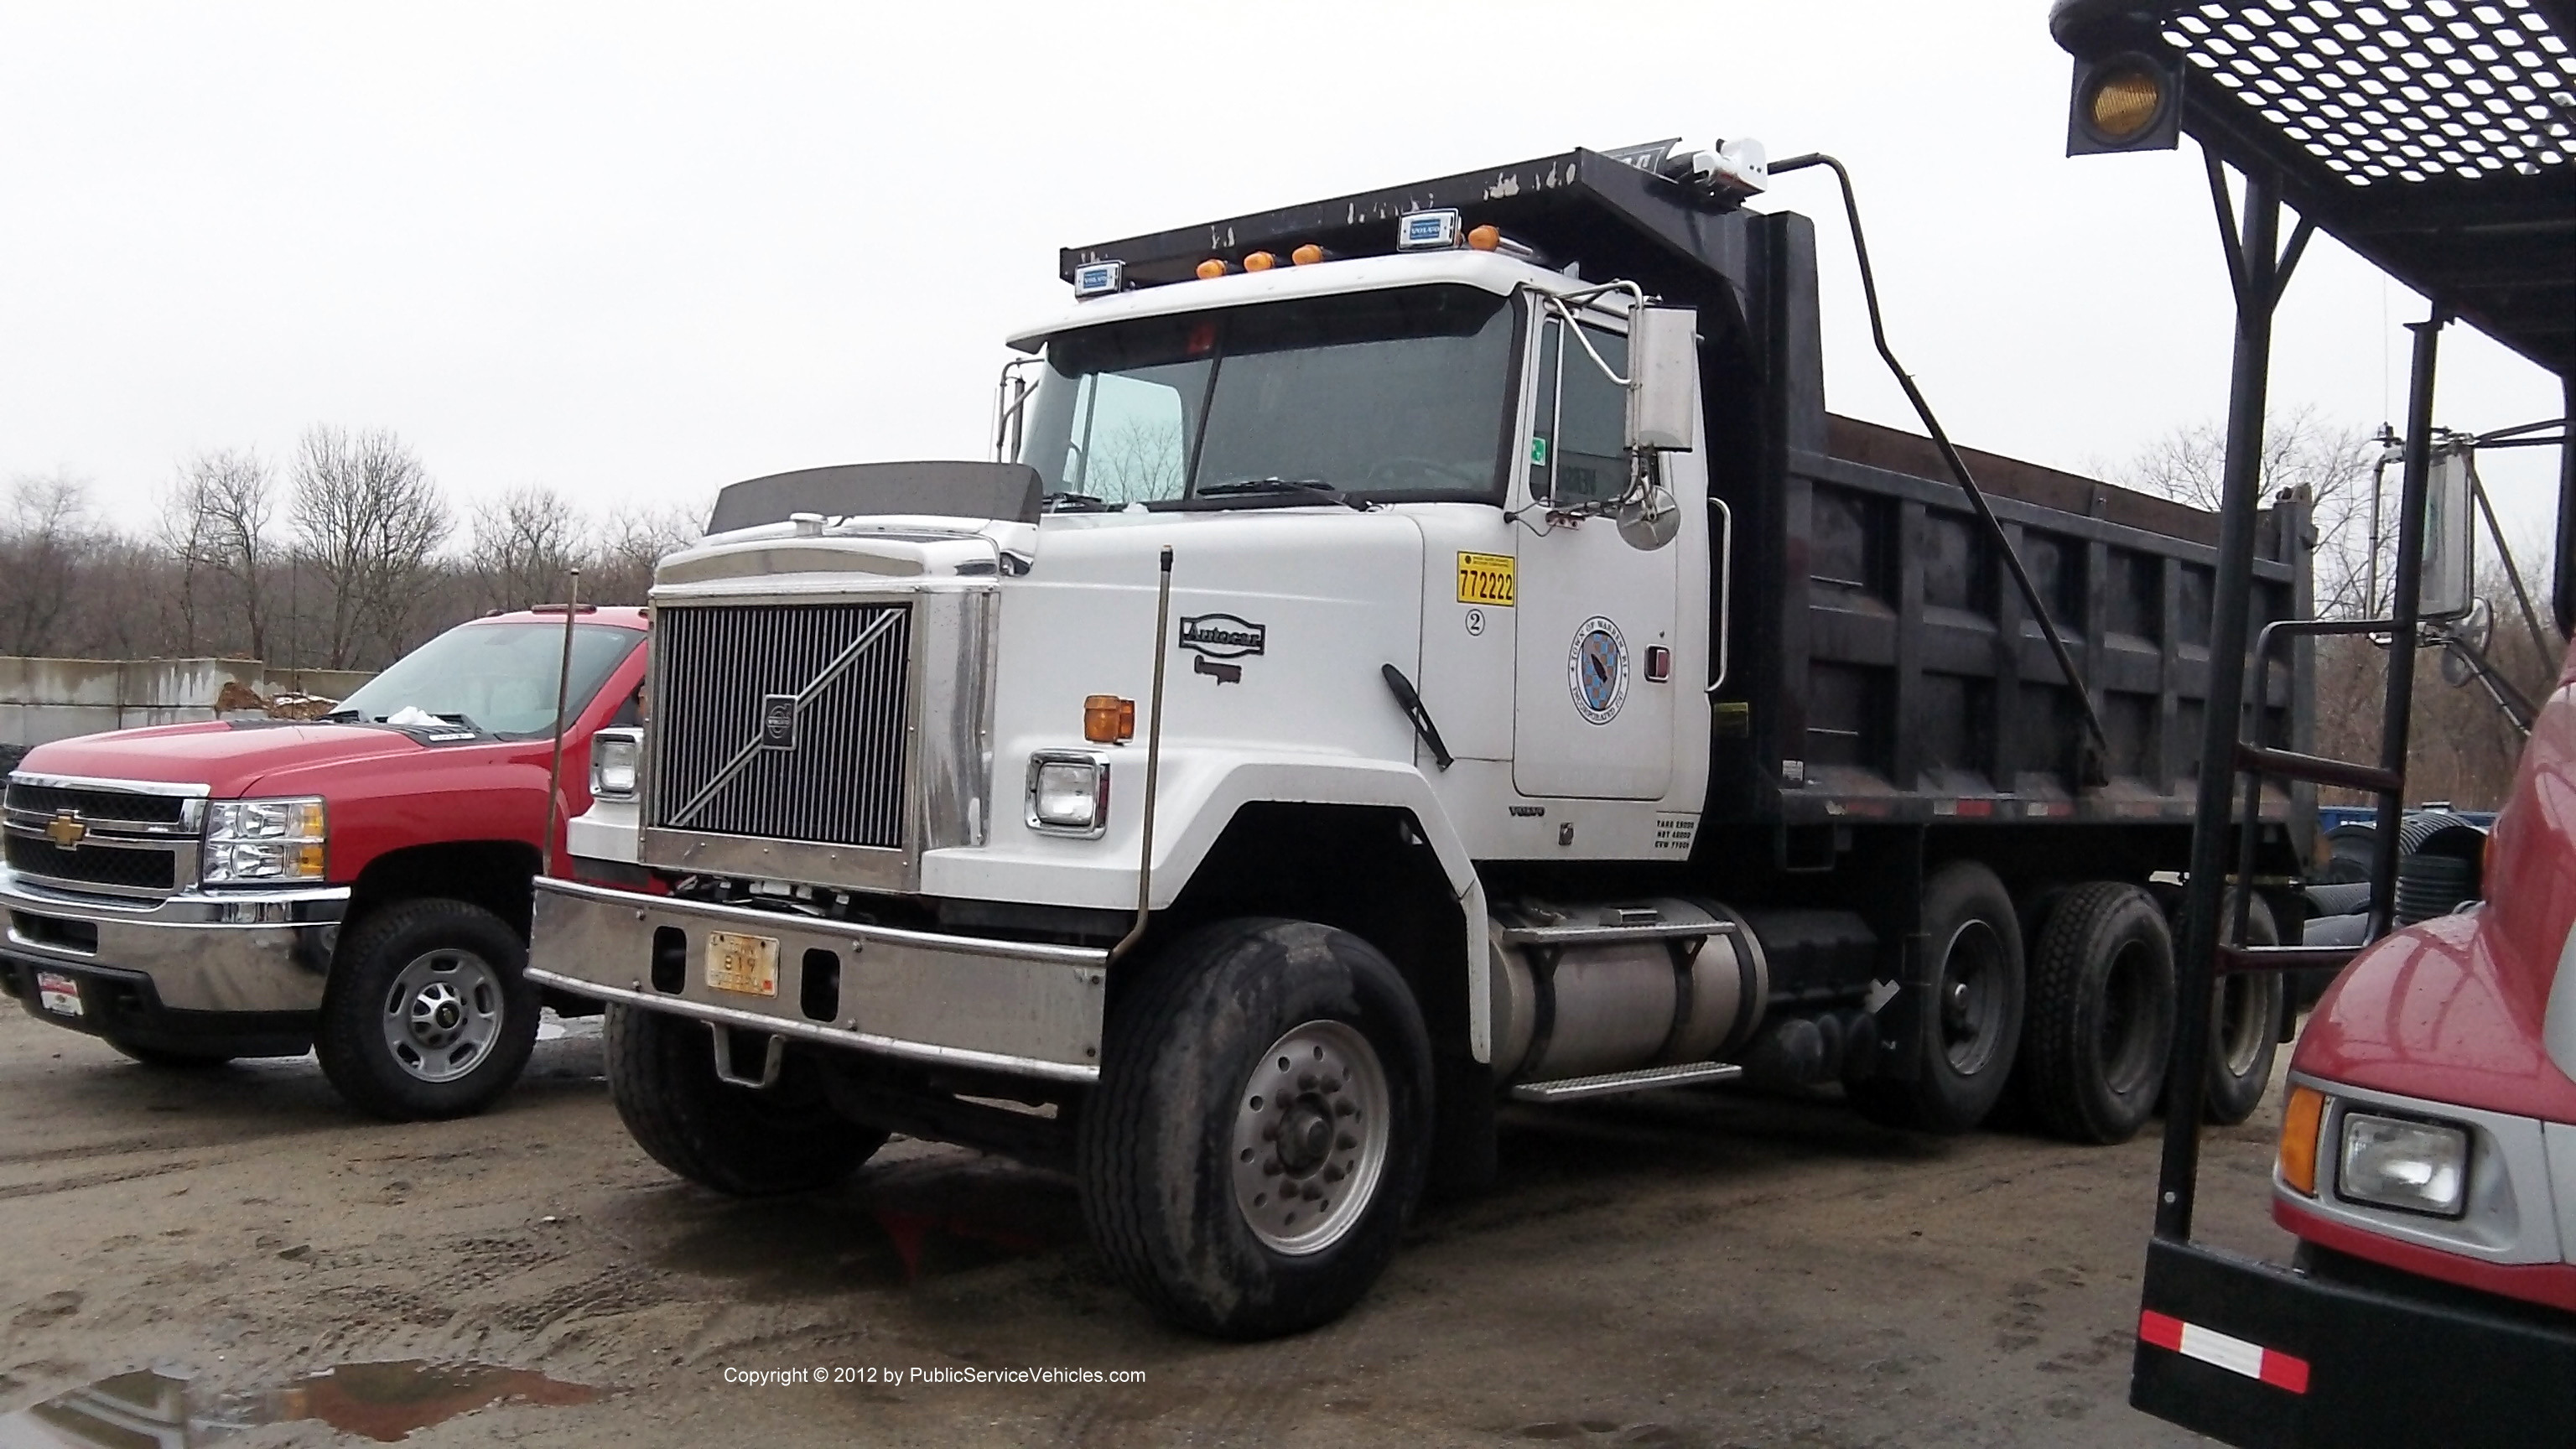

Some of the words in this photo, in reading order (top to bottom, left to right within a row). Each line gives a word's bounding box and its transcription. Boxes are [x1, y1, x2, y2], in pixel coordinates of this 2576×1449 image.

[1461, 569, 1513, 600] 772222
[1183, 622, 1262, 647] Autocar
[1470, 613, 1480, 631] 2
[1571, 631, 1586, 660] TOWN
[1586, 621, 1595, 631] OF
[1597, 621, 1624, 649] WARREN
[725, 956, 755, 972] 819
